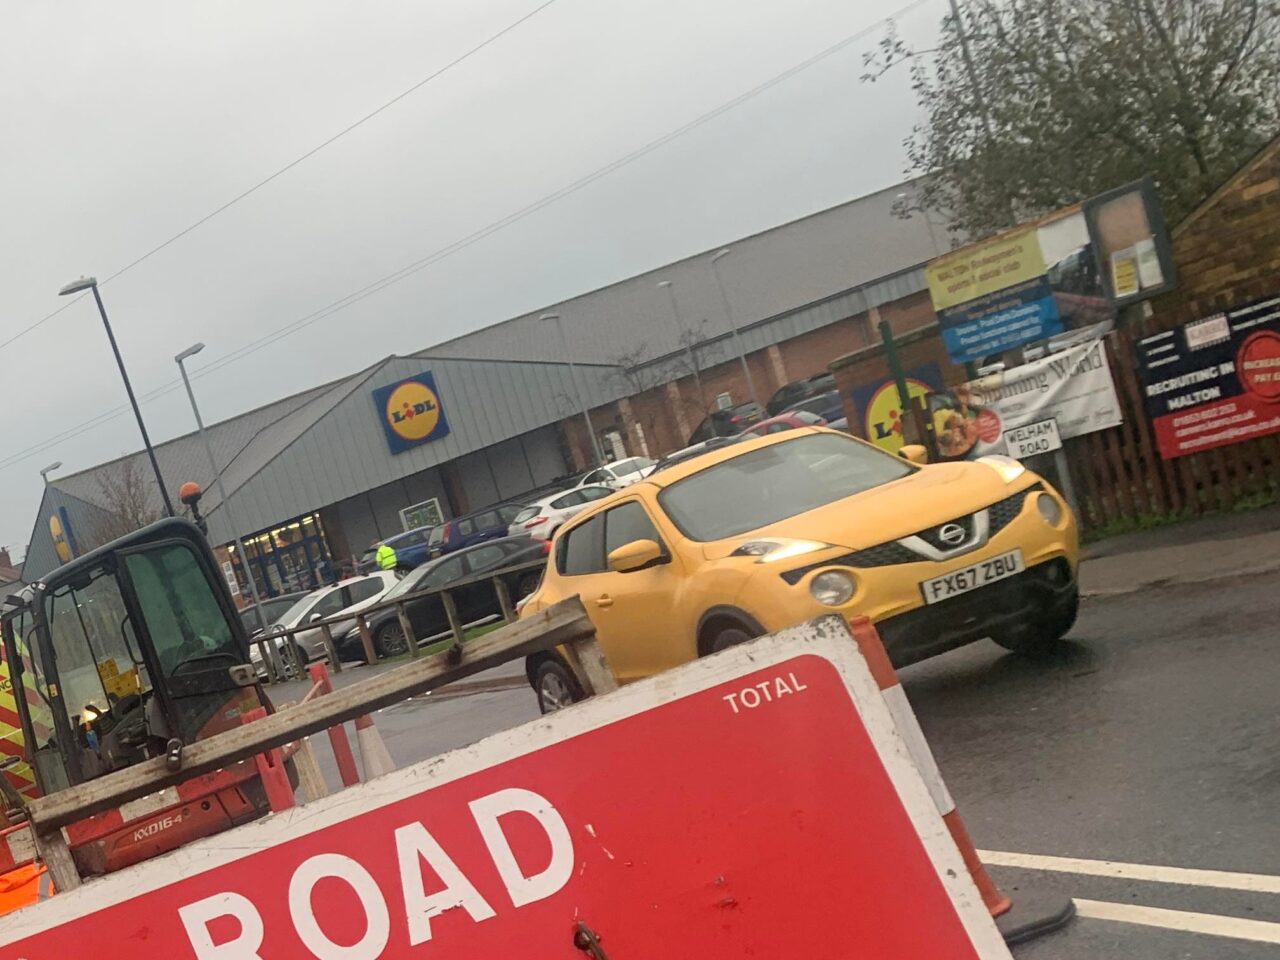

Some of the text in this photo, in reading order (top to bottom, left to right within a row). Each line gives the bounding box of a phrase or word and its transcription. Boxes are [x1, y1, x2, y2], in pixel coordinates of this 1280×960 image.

[1146, 361, 1236, 397] RECRUITING IN
[1168, 386, 1221, 410] MALTON
[1008, 422, 1053, 444] WELHAM
[1020, 439, 1050, 455] ROAD
[931, 554, 1016, 599] FX67 ZBU
[723, 672, 807, 713] TOTAL
